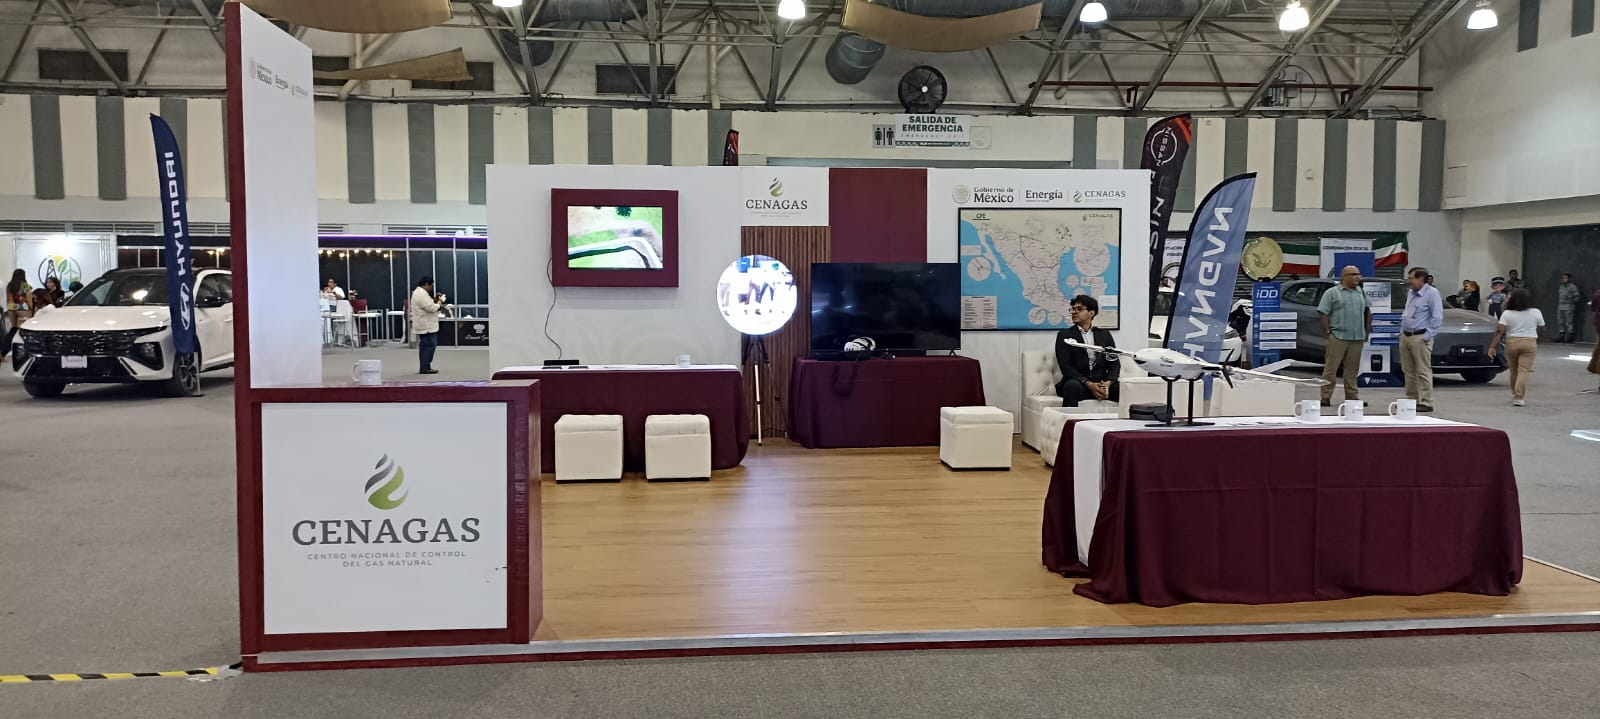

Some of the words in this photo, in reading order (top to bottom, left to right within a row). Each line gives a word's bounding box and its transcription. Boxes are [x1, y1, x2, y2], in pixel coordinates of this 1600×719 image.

[909, 115, 943, 124] SALIDA
[944, 116, 957, 124] DE
[902, 124, 963, 132] EMERGENCIA
[1156, 126, 1172, 167] NISSAN
[973, 192, 1014, 203] México
[1025, 189, 1063, 201] Energía
[1084, 190, 1126, 198] CENAGAS
[745, 199, 808, 210] CENAGAS
[165, 151, 187, 276] HYUNDAI
[1256, 289, 1278, 298] iDD
[1366, 290, 1389, 298] REEV
[292, 517, 481, 545] CENAGAS
